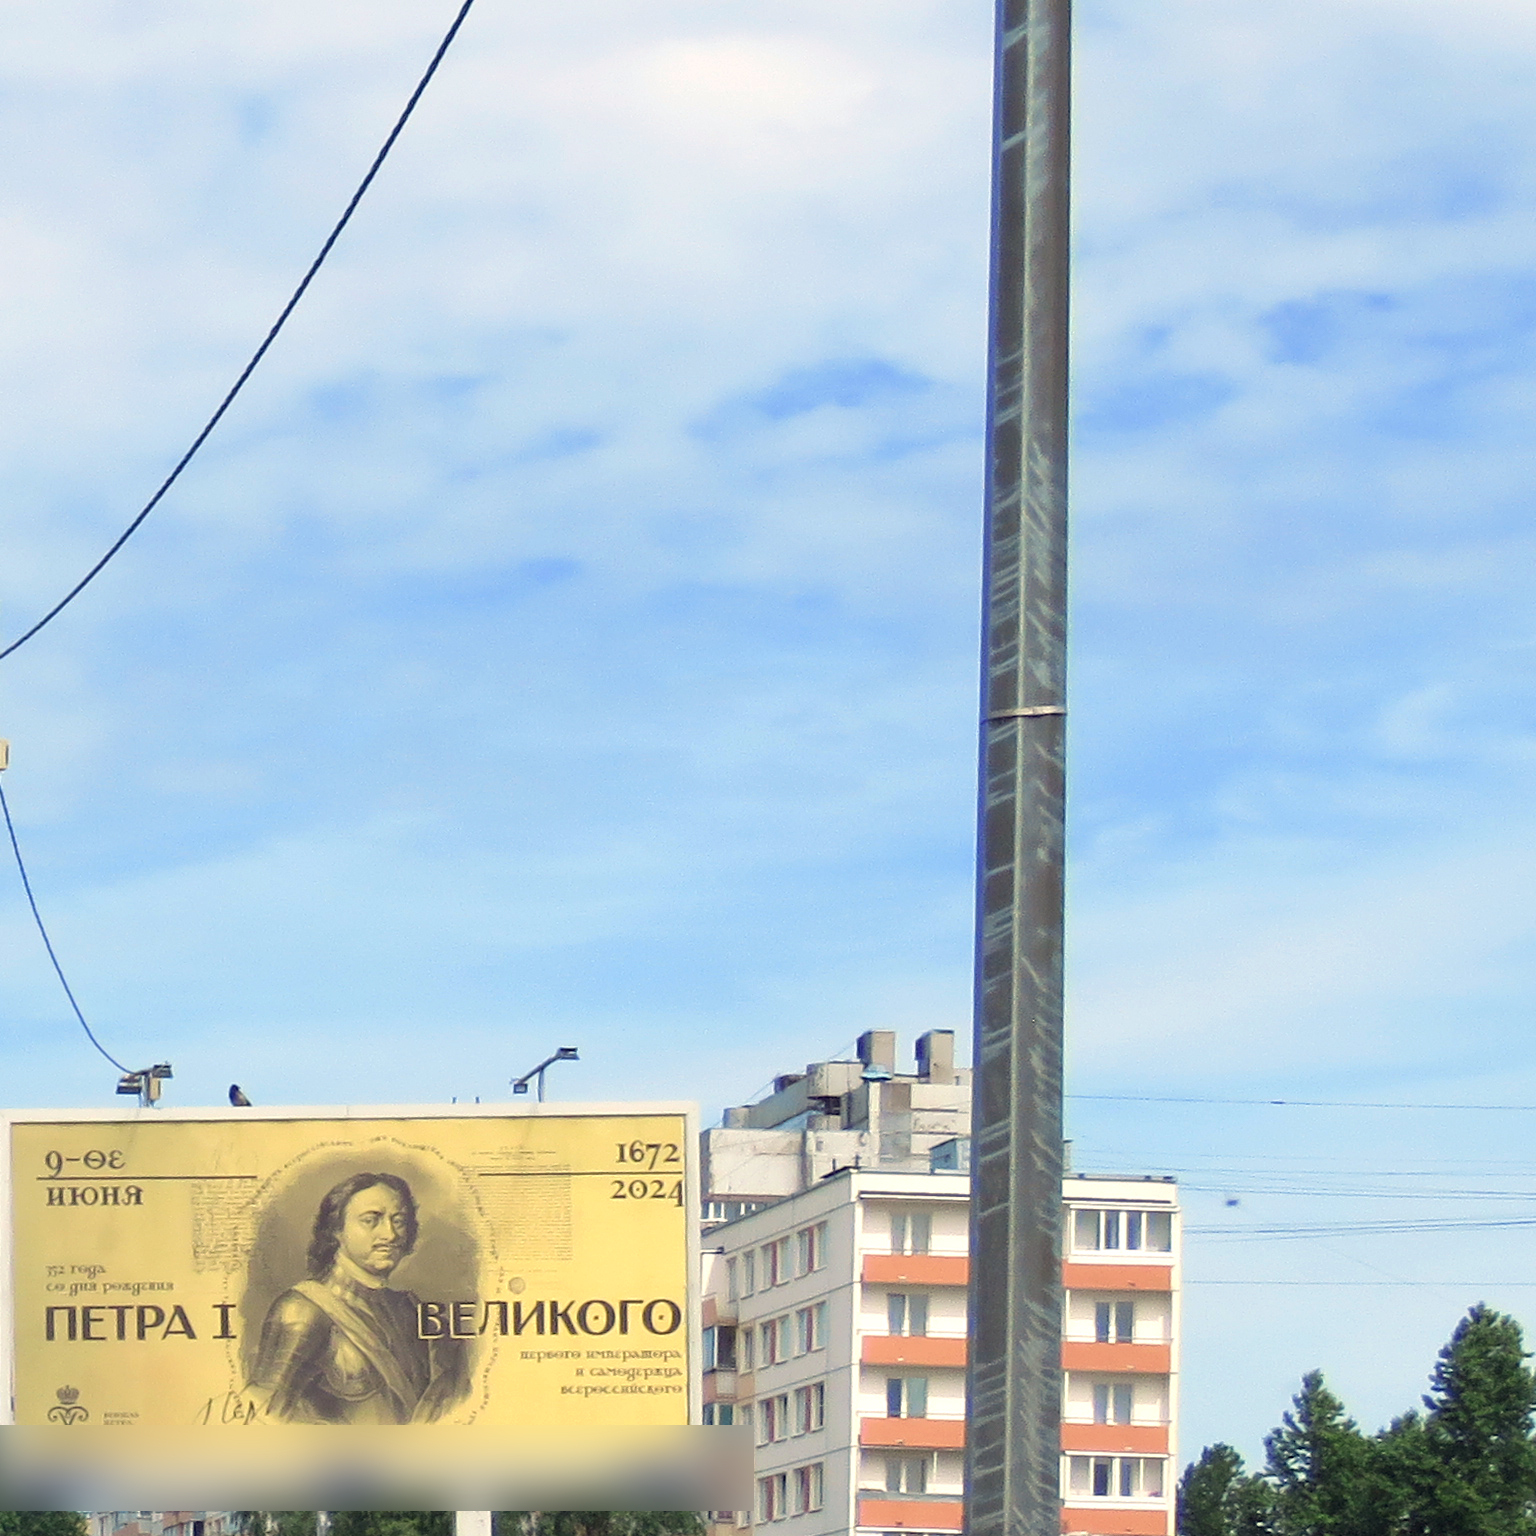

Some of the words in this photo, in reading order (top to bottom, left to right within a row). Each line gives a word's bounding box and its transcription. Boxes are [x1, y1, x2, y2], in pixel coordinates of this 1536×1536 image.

[615, 1140, 681, 1170] 1672
[610, 1179, 685, 1208] 2024
[46, 1304, 198, 1341] ПЕТРА
[417, 1299, 682, 1339] ВЕЛИКОГО
